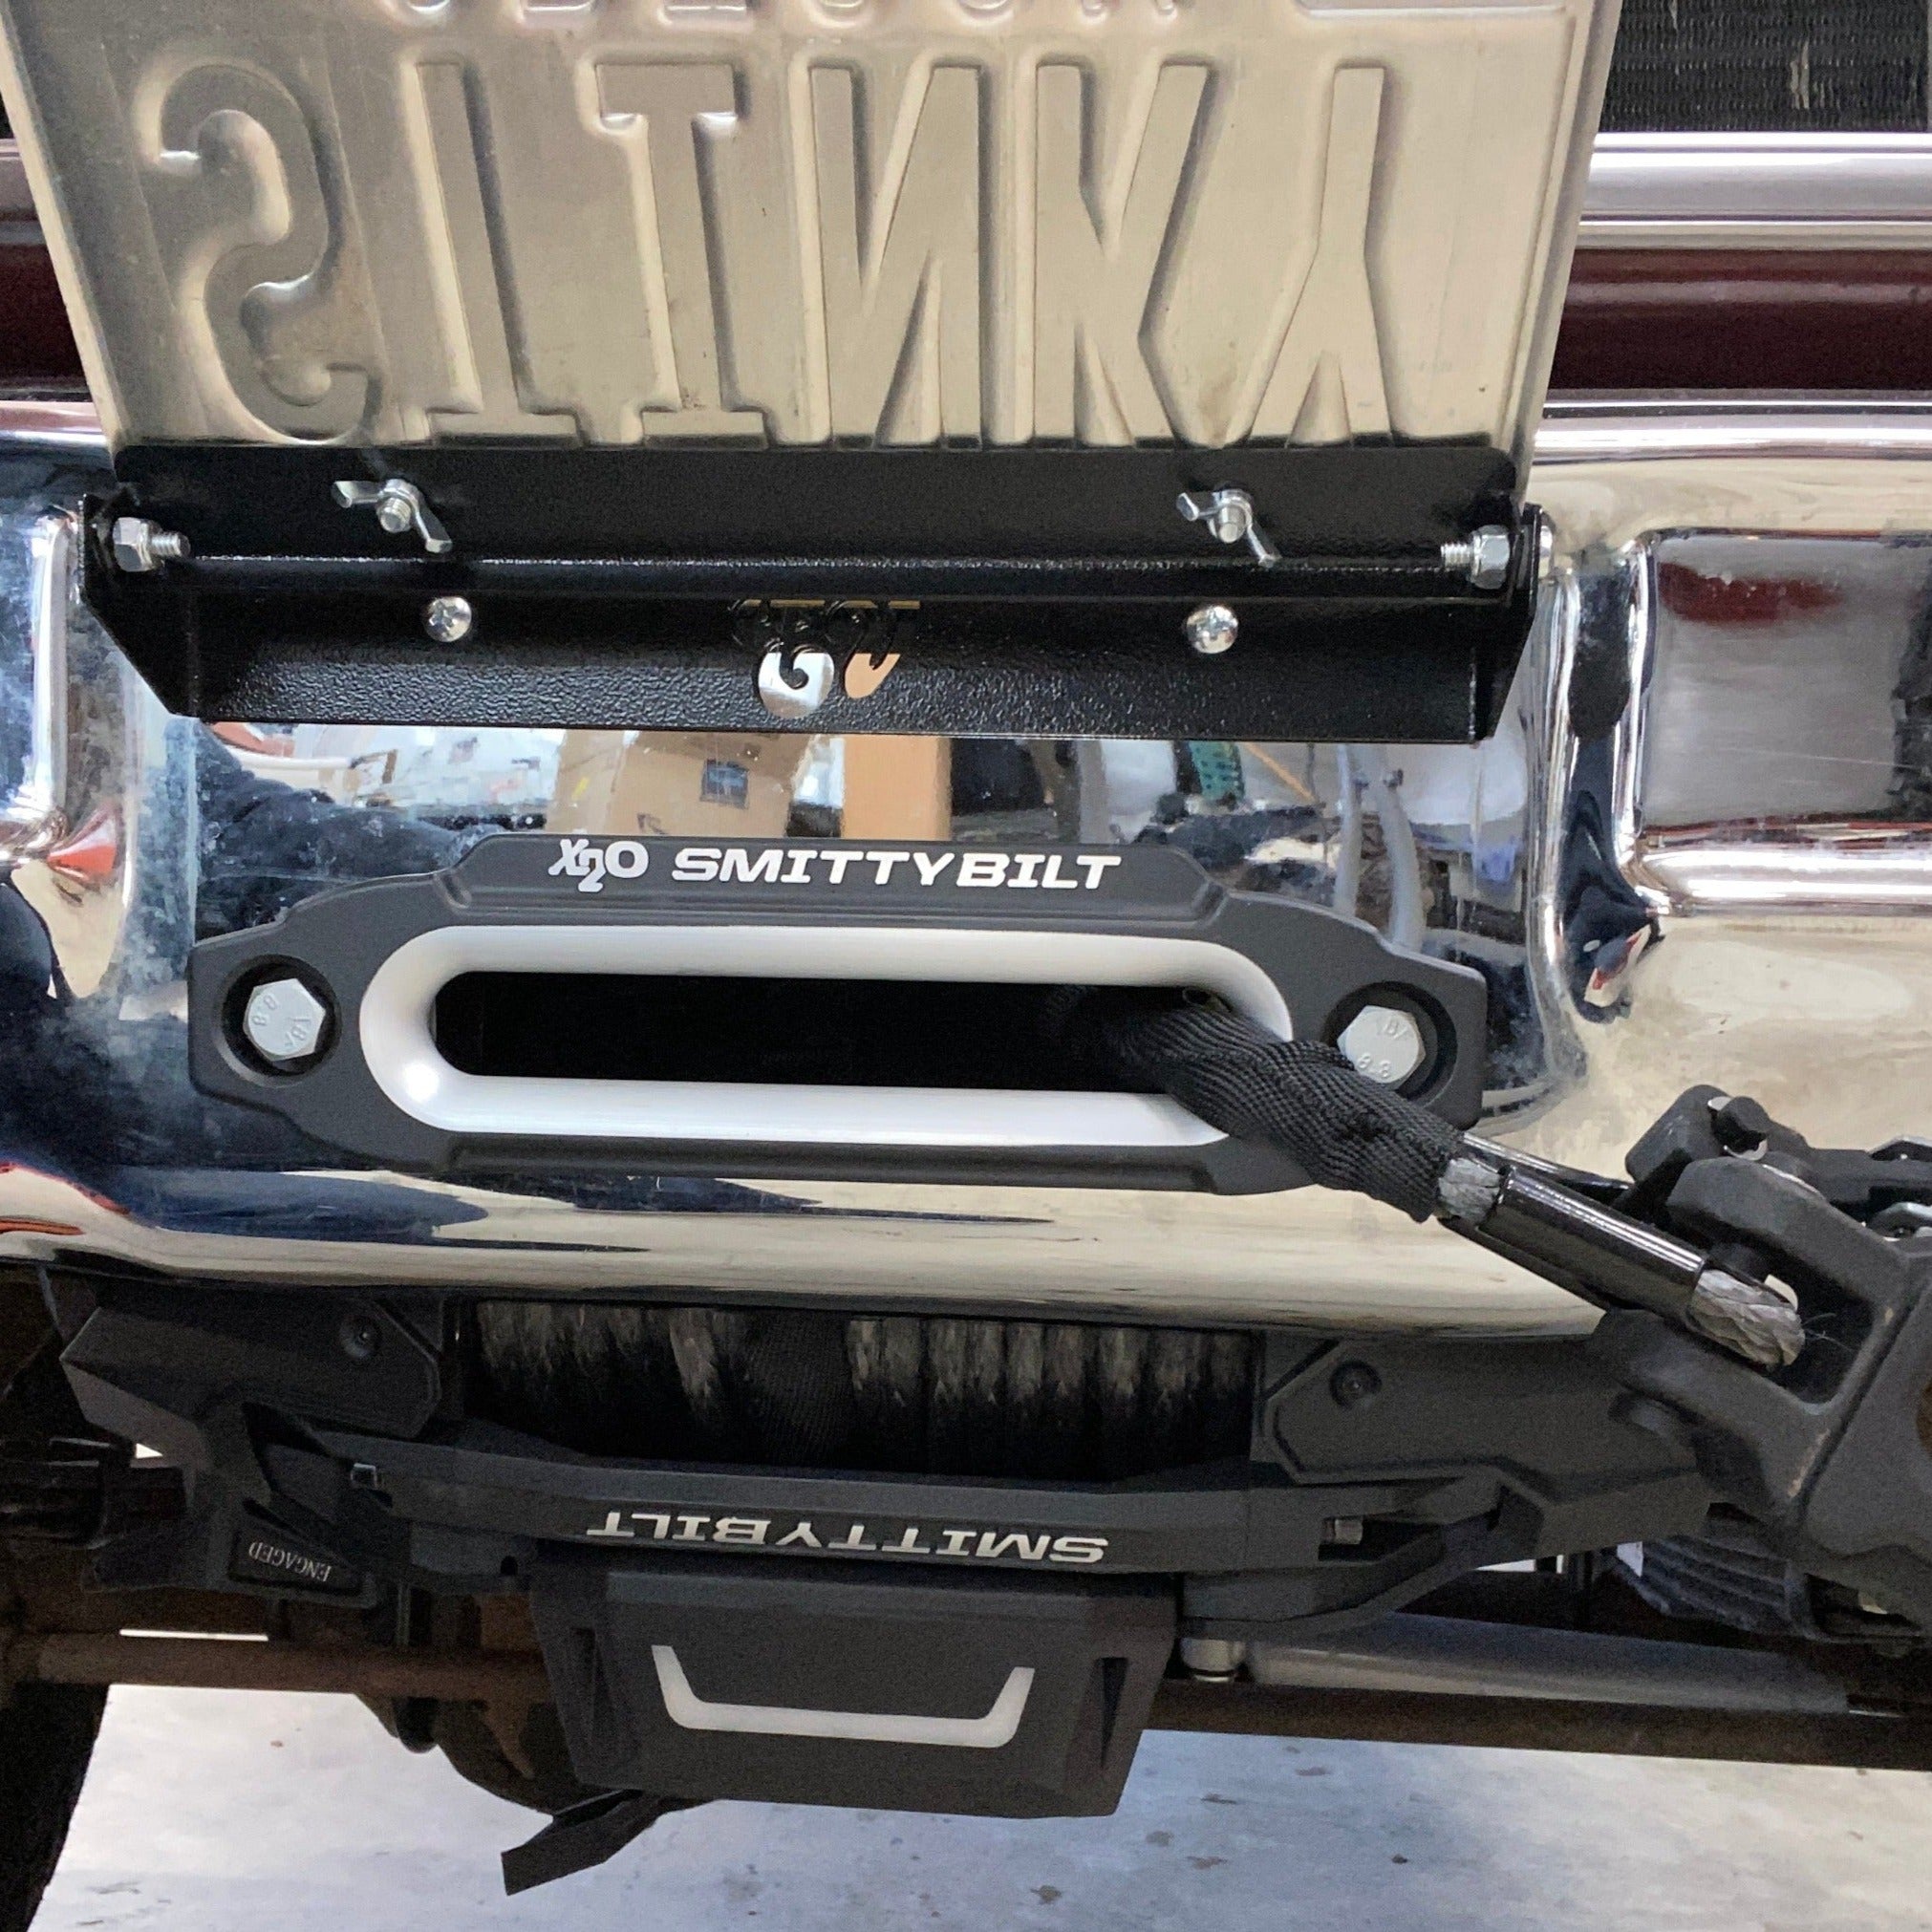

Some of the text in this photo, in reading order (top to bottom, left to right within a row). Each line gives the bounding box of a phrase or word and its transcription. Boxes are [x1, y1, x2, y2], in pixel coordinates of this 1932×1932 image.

[672, 848, 1122, 890] SMITTYBILT
[586, 1512, 1109, 1563] SMITTYBILT
[248, 1541, 333, 1582] ENGAGED
